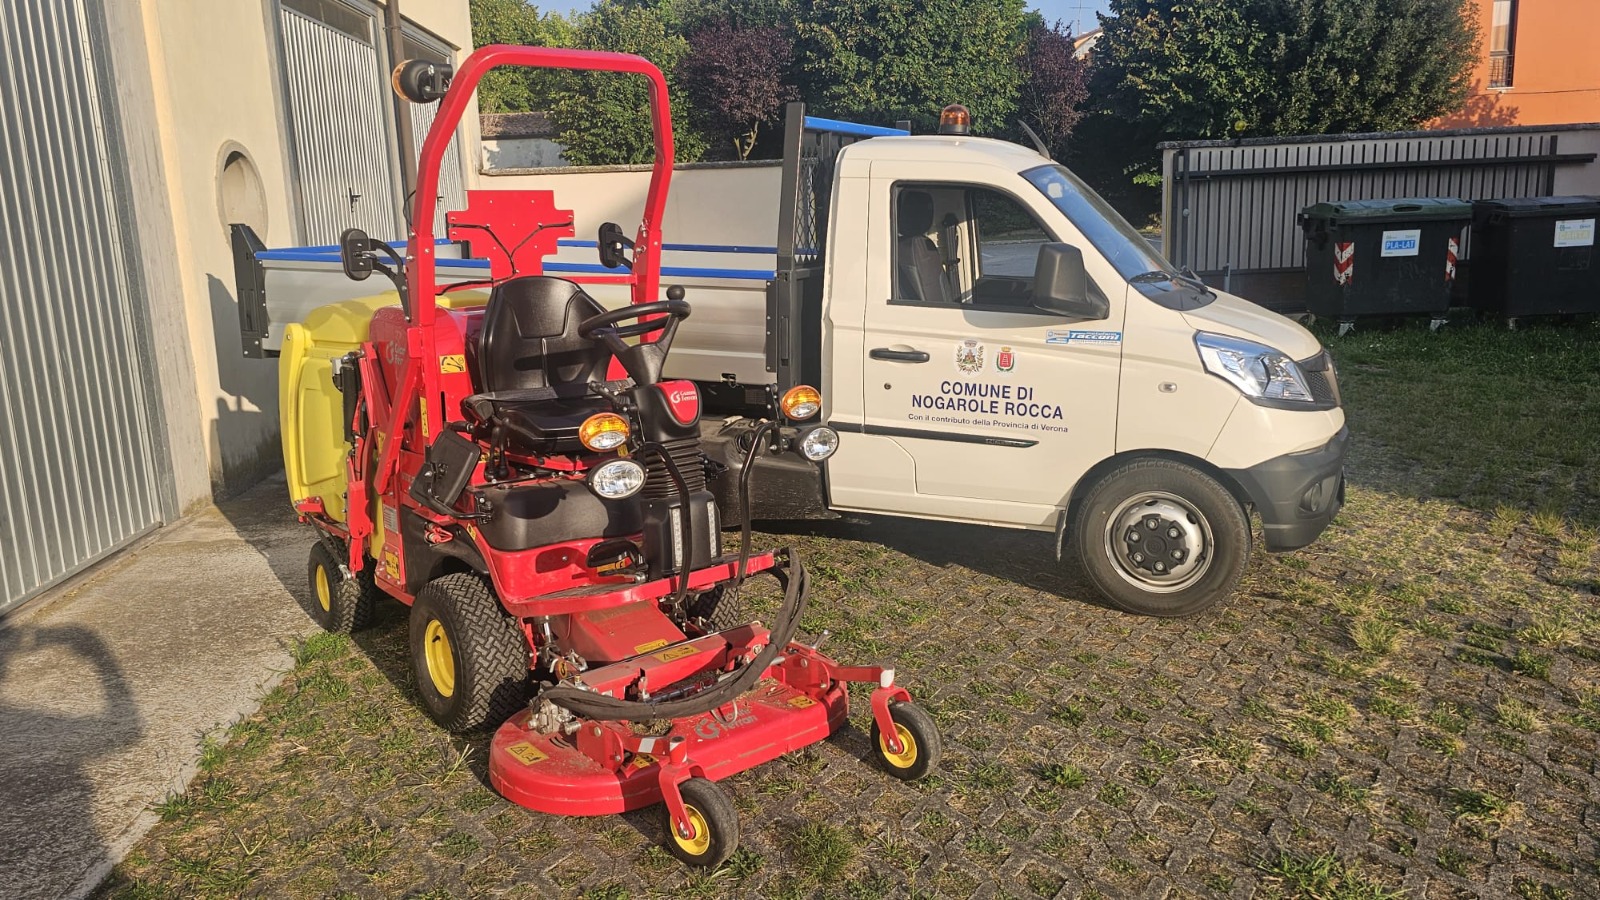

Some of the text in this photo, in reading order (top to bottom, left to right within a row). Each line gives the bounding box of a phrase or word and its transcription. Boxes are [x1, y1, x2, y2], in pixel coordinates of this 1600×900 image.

[1386, 240, 1415, 249] PLA-LAT
[941, 381, 1034, 400] COMUNE DI
[912, 395, 1063, 420] NOGAROLE ROCCA
[908, 413, 923, 421] Con
[931, 415, 970, 425] contributo
[972, 417, 991, 426] della
[992, 419, 1029, 430] Provincia
[1031, 422, 1039, 430] di
[1040, 424, 1068, 433] Verona
